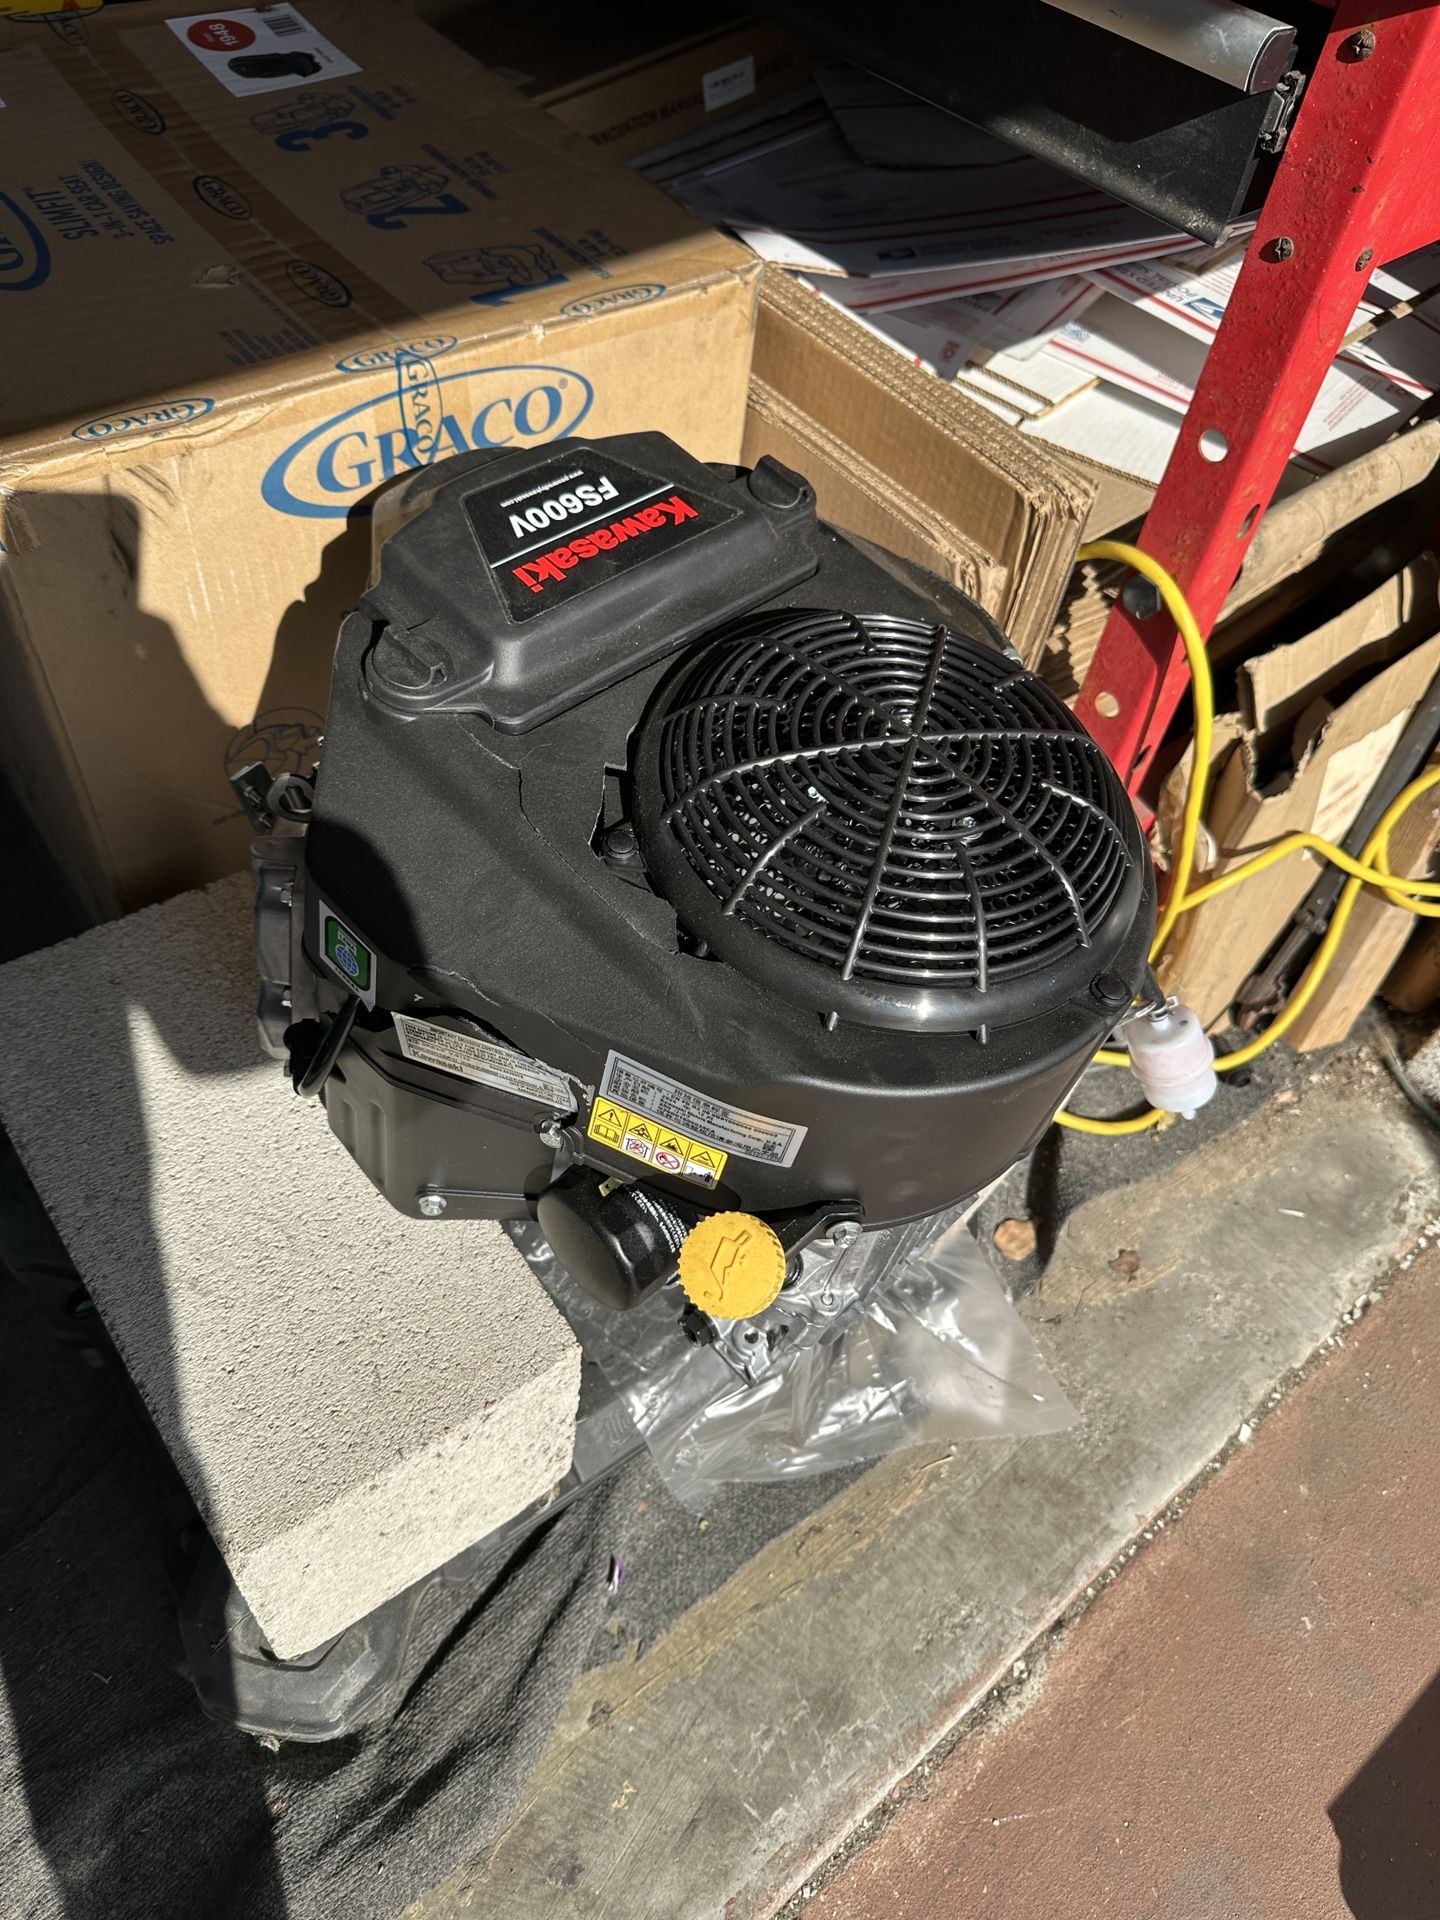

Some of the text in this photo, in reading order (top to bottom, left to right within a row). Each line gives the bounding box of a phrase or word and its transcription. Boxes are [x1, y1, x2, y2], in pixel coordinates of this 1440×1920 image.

[207, 22, 239, 48] 1948
[118, 91, 159, 132] GRACO
[274, 120, 370, 153] 3
[26, 190, 98, 241] SLIMFIT
[203, 176, 249, 219] GRACO
[367, 193, 473, 231] 2
[291, 261, 346, 304] GRACO
[469, 276, 572, 307] 1
[570, 285, 652, 316] GRACO
[351, 335, 447, 369] GRACO
[88, 403, 197, 438] GRACO
[404, 360, 435, 456] GRACO
[315, 384, 564, 493] GRACO
[507, 476, 620, 539] FS600V
[512, 495, 700, 594] Kawasaki
